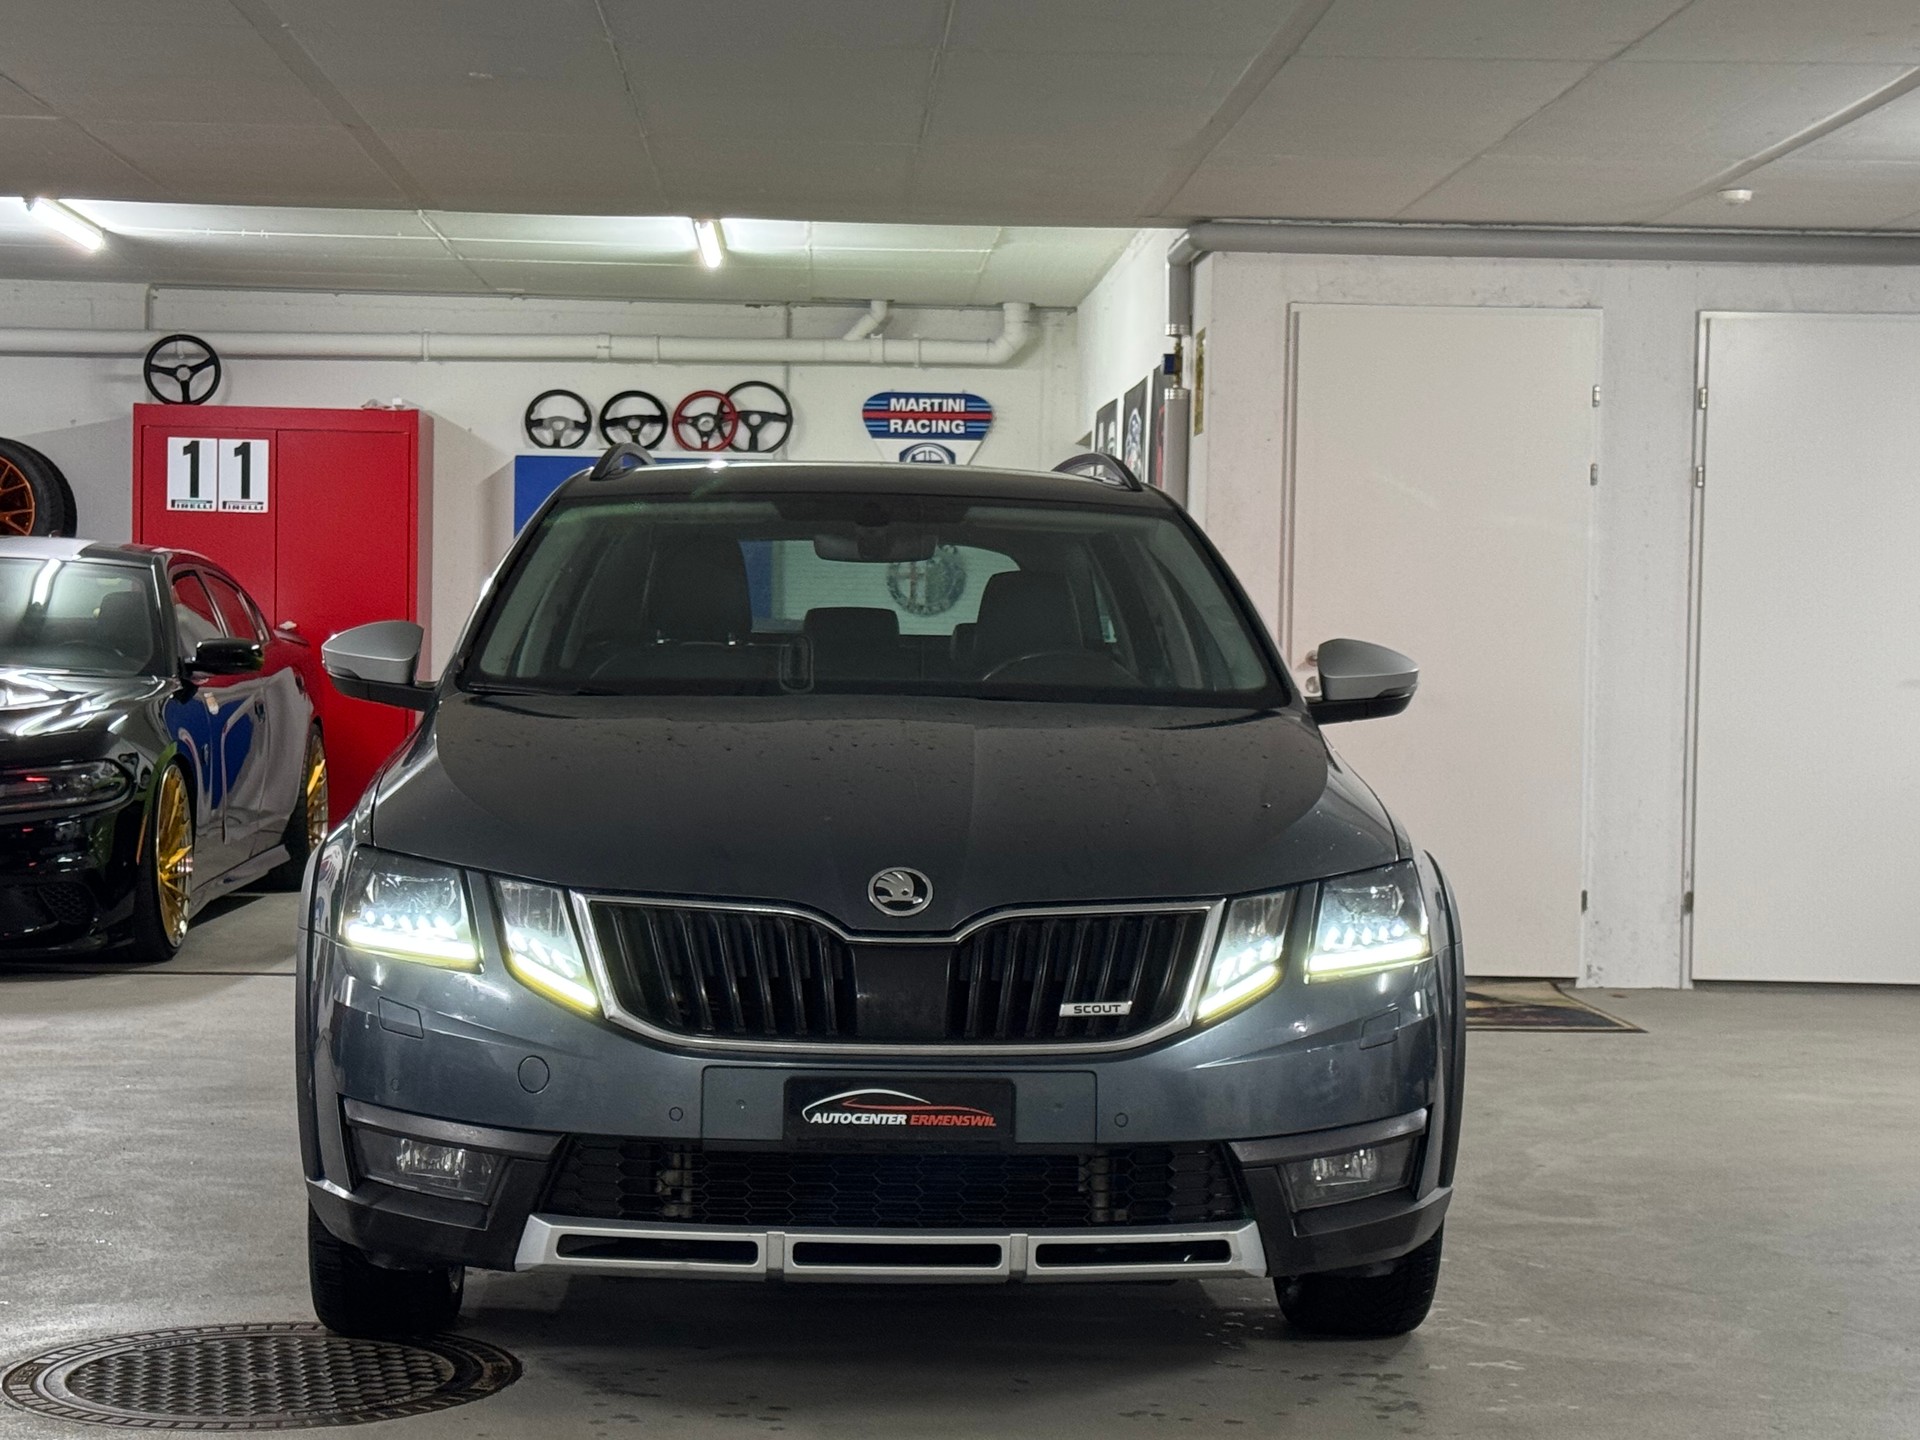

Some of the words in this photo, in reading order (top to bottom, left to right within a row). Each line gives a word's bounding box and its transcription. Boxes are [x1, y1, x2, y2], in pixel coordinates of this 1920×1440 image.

[889, 398, 966, 412] MARTINI
[889, 419, 966, 434] RACING
[1073, 1004, 1121, 1014] SCOUT
[810, 1112, 907, 1125] AUTOCENTER
[909, 1114, 997, 1127] ERMENSWIL
